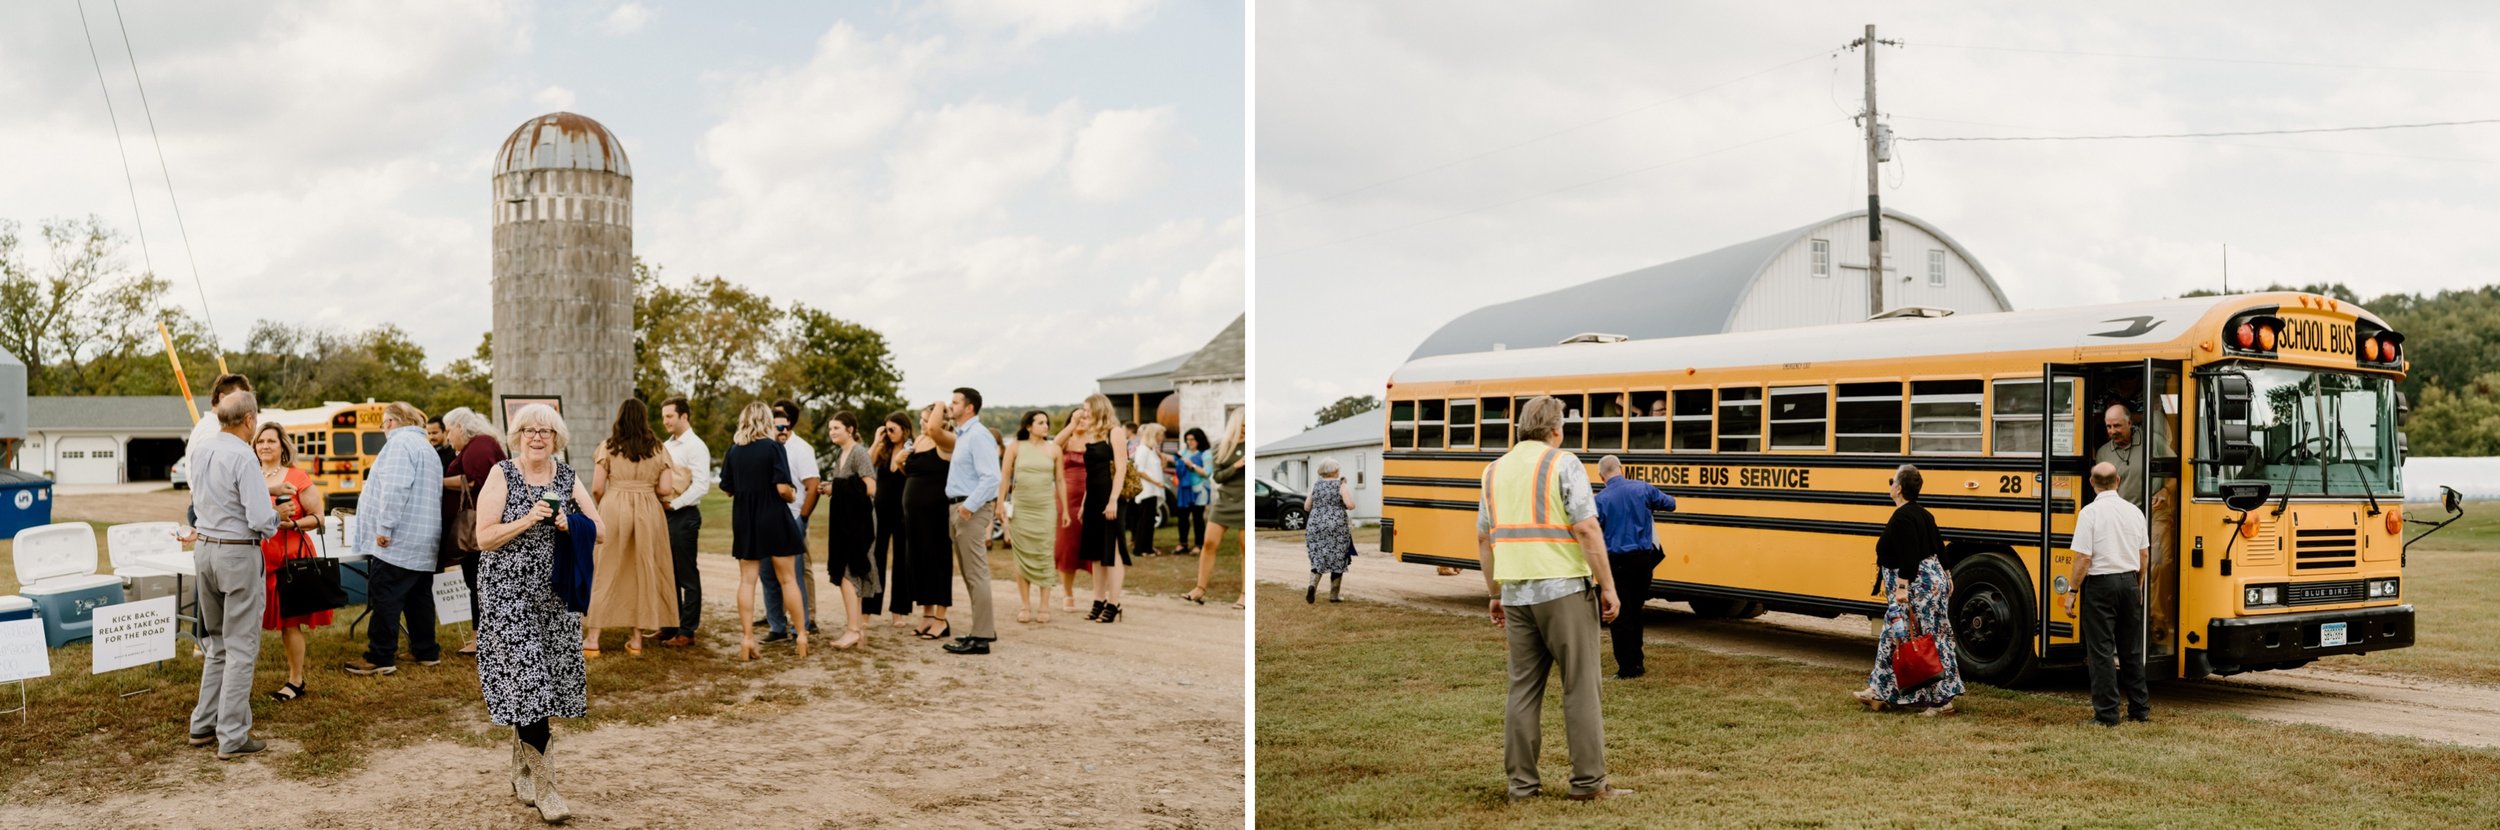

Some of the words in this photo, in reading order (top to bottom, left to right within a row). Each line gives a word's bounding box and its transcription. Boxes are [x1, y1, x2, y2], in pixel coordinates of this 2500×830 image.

[2279, 316, 2327, 352] SCHOOL
[2330, 323, 2354, 355] BUS
[360, 413, 384, 424] SCHOO
[1624, 466, 1690, 485] MELROSE
[1699, 466, 1729, 486] BUS
[1740, 468, 1810, 488] SERVICE
[1999, 475, 2022, 494] 28
[2304, 589, 2325, 597] BLUE
[112, 614, 132, 623] KICK
[134, 610, 159, 619] BACK,
[99, 625, 124, 635] RELAX
[134, 619, 152, 629] TAKE
[154, 617, 171, 625] ONE
[105, 634, 122, 644] FOR
[124, 632, 140, 640] THE
[142, 627, 165, 637] ROAD
